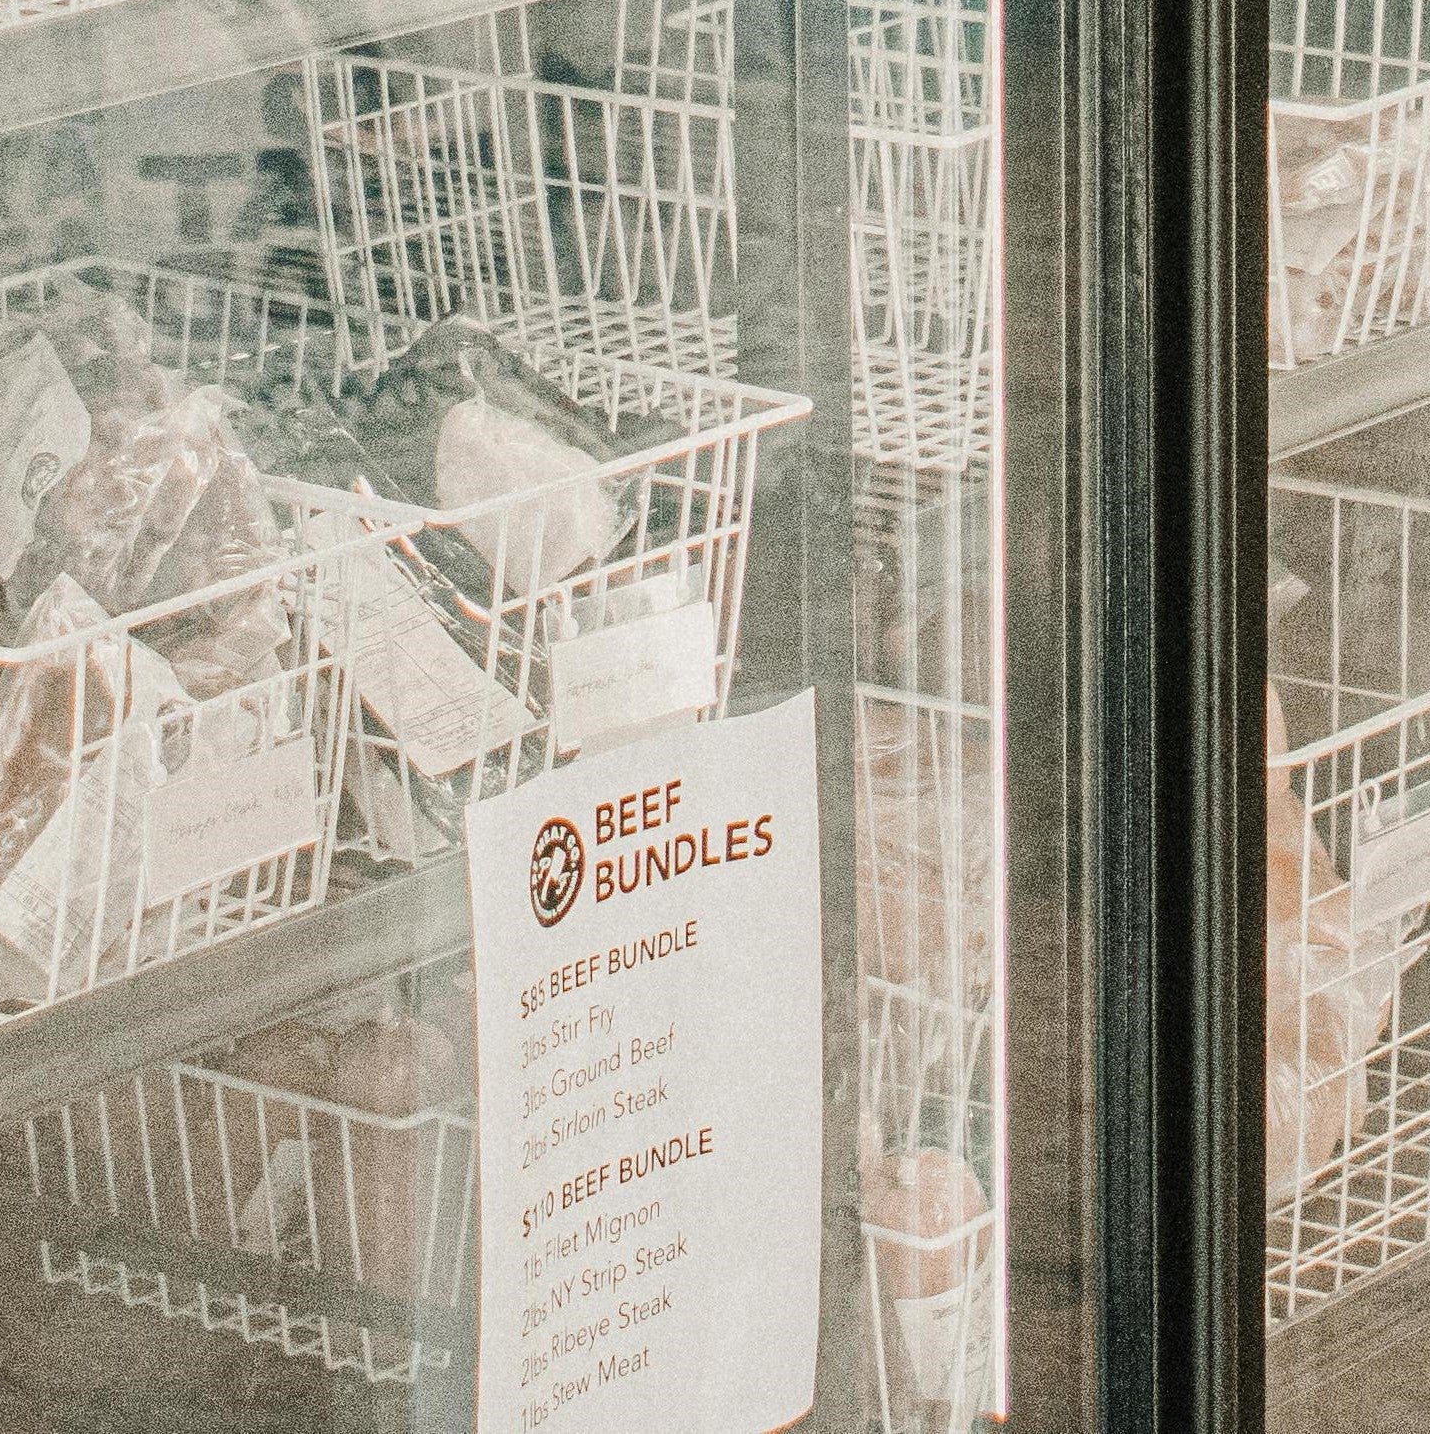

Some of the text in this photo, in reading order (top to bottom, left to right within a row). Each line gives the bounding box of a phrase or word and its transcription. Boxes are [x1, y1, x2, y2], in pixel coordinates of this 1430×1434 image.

[595, 778, 683, 846] BEEF
[595, 814, 773, 903] BUNDLES
[520, 920, 699, 1020] $85 BEEF BUNDLE
[551, 1015, 582, 1049] Stir
[589, 1004, 616, 1035] Fry
[551, 1041, 621, 1097] Ground
[630, 1021, 676, 1066] Beef
[551, 1103, 607, 1147] Sirloin
[613, 1076, 670, 1120] Steak
[522, 1127, 714, 1239] $110 BEEF BUNDLE
[546, 1230, 579, 1263] Filet
[585, 1199, 662, 1245] Mignon
[551, 1274, 576, 1313] NY
[582, 1260, 627, 1297] Strip
[636, 1230, 688, 1275] Steak
[552, 1317, 610, 1359] Ribeye
[618, 1284, 672, 1330] Steak
[552, 1373, 592, 1411] Stew
[598, 1345, 650, 1386] Meat
